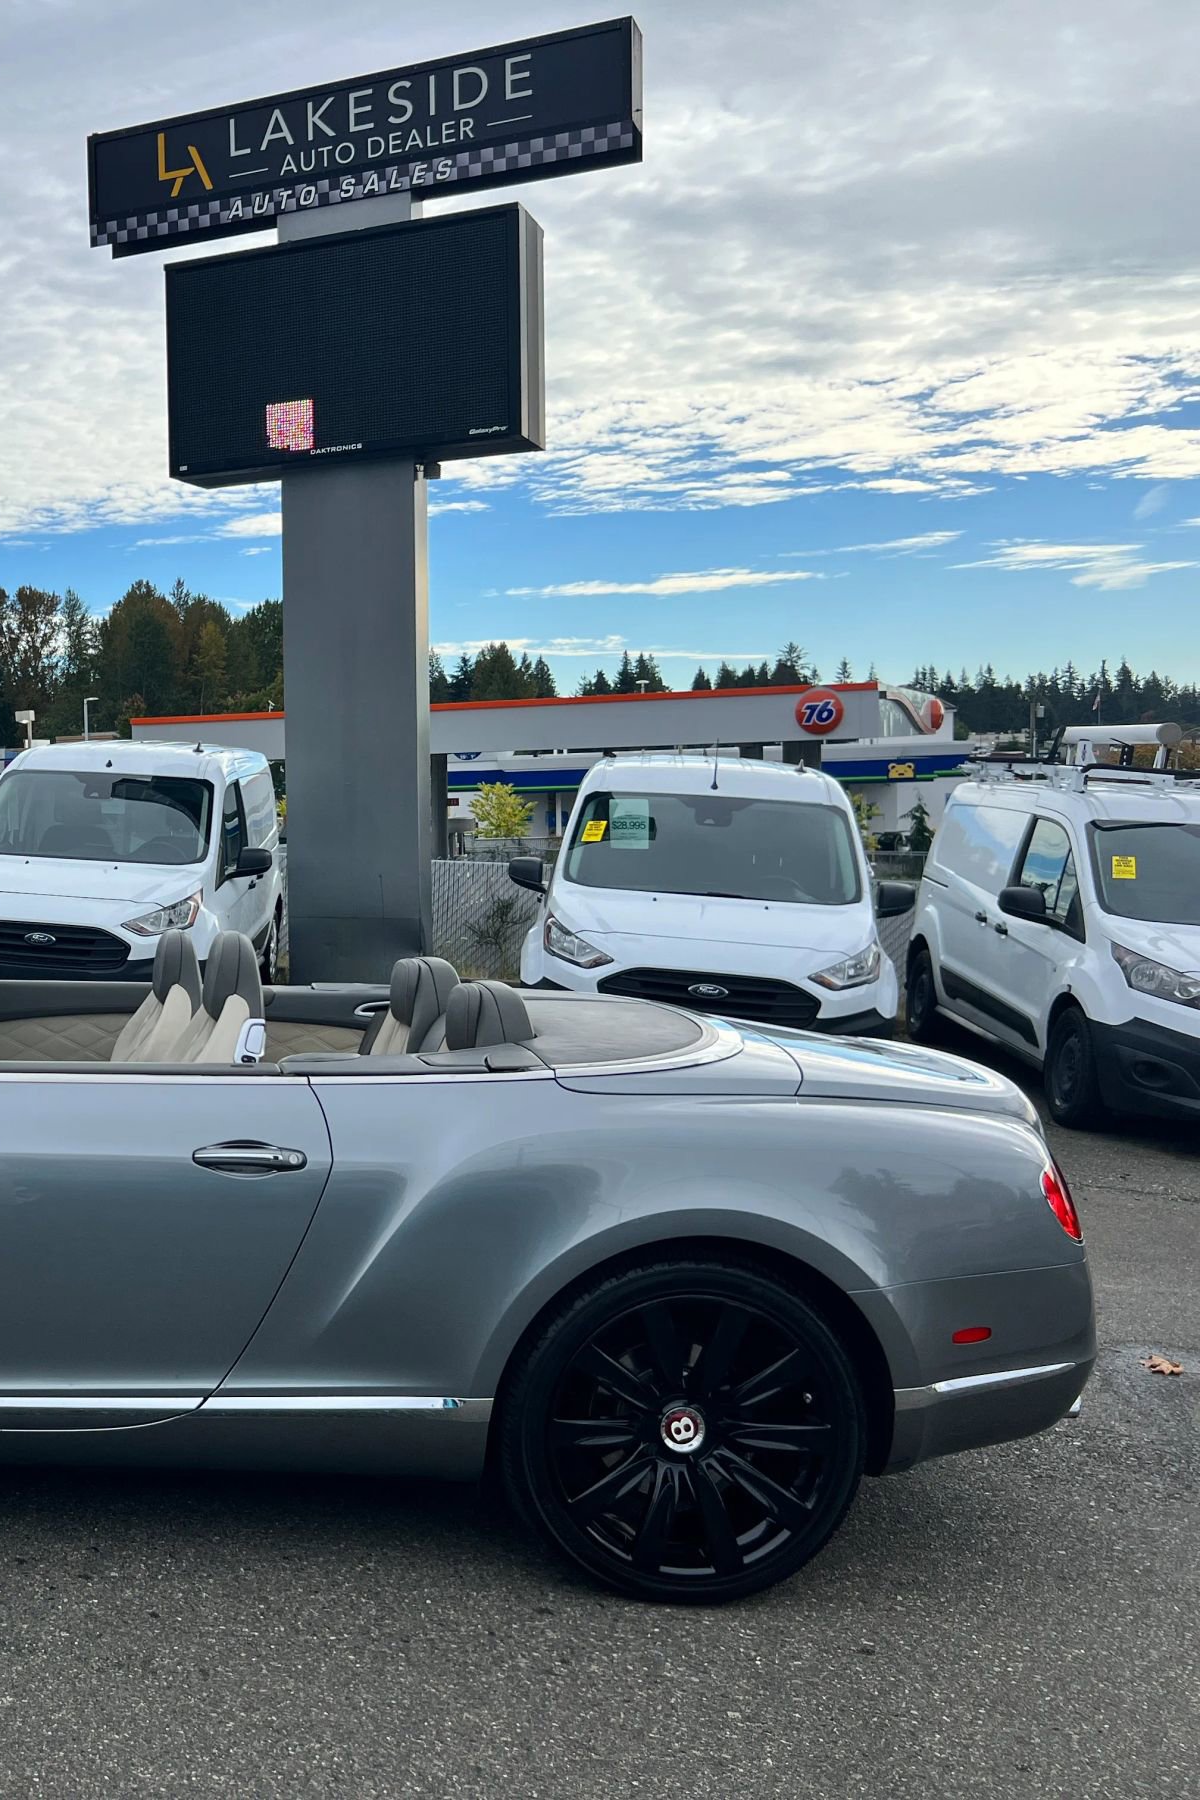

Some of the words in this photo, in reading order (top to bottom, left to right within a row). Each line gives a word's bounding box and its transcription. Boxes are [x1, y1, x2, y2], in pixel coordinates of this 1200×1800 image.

[229, 54, 533, 157] LAKESIDE
[280, 142, 355, 176] AUTO
[367, 117, 475, 159] DEALER
[228, 185, 316, 220] AUTO
[340, 158, 453, 198] SALES
[310, 443, 362, 455] DAKTRONICS
[801, 700, 836, 725] 76
[612, 821, 647, 831] $28,995
